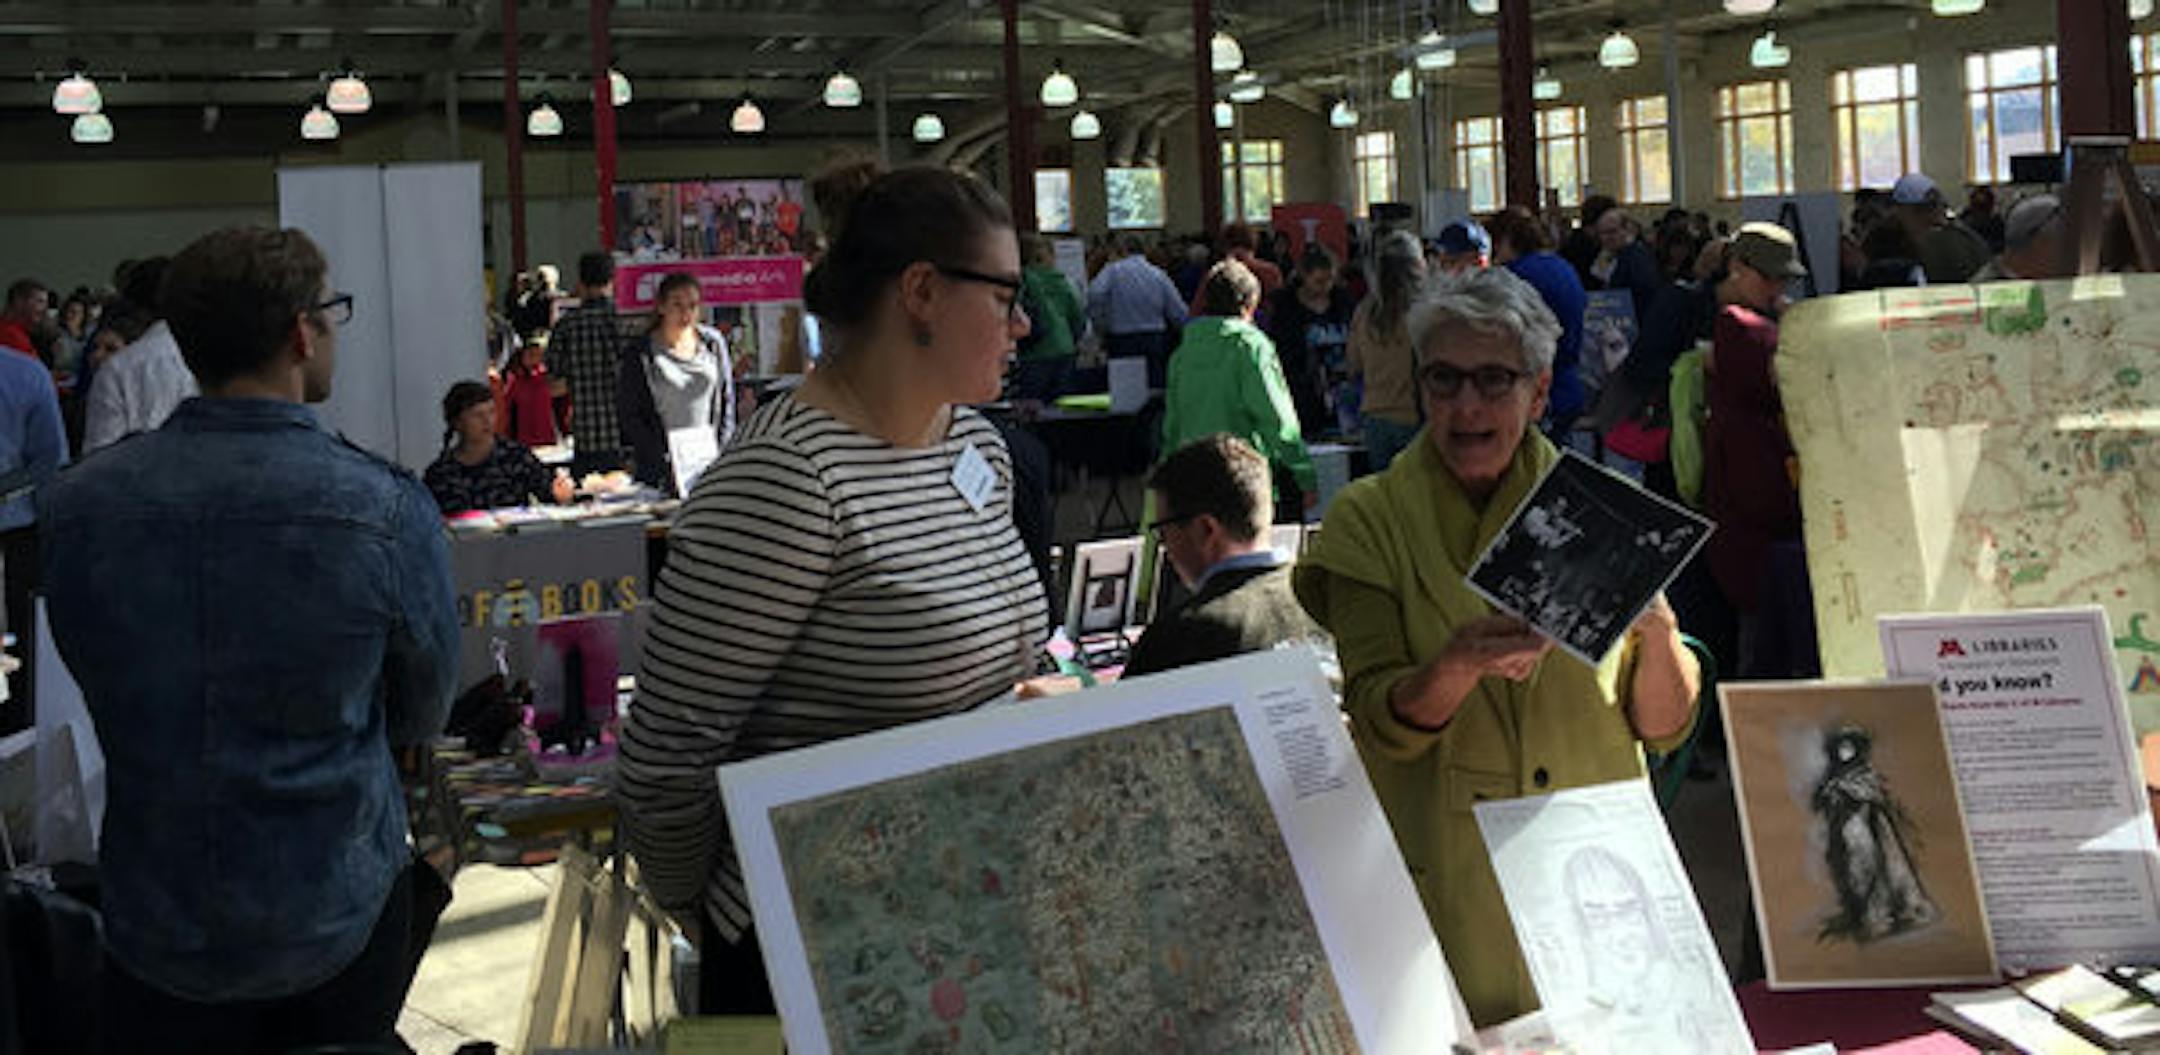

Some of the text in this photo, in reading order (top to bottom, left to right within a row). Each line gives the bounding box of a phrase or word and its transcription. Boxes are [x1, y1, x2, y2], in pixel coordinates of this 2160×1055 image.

[542, 575, 638, 620] BOOKS
[1972, 636, 2059, 652] LIBRARIES
[1955, 679, 1987, 696] you
[1991, 672, 2053, 691] know?
